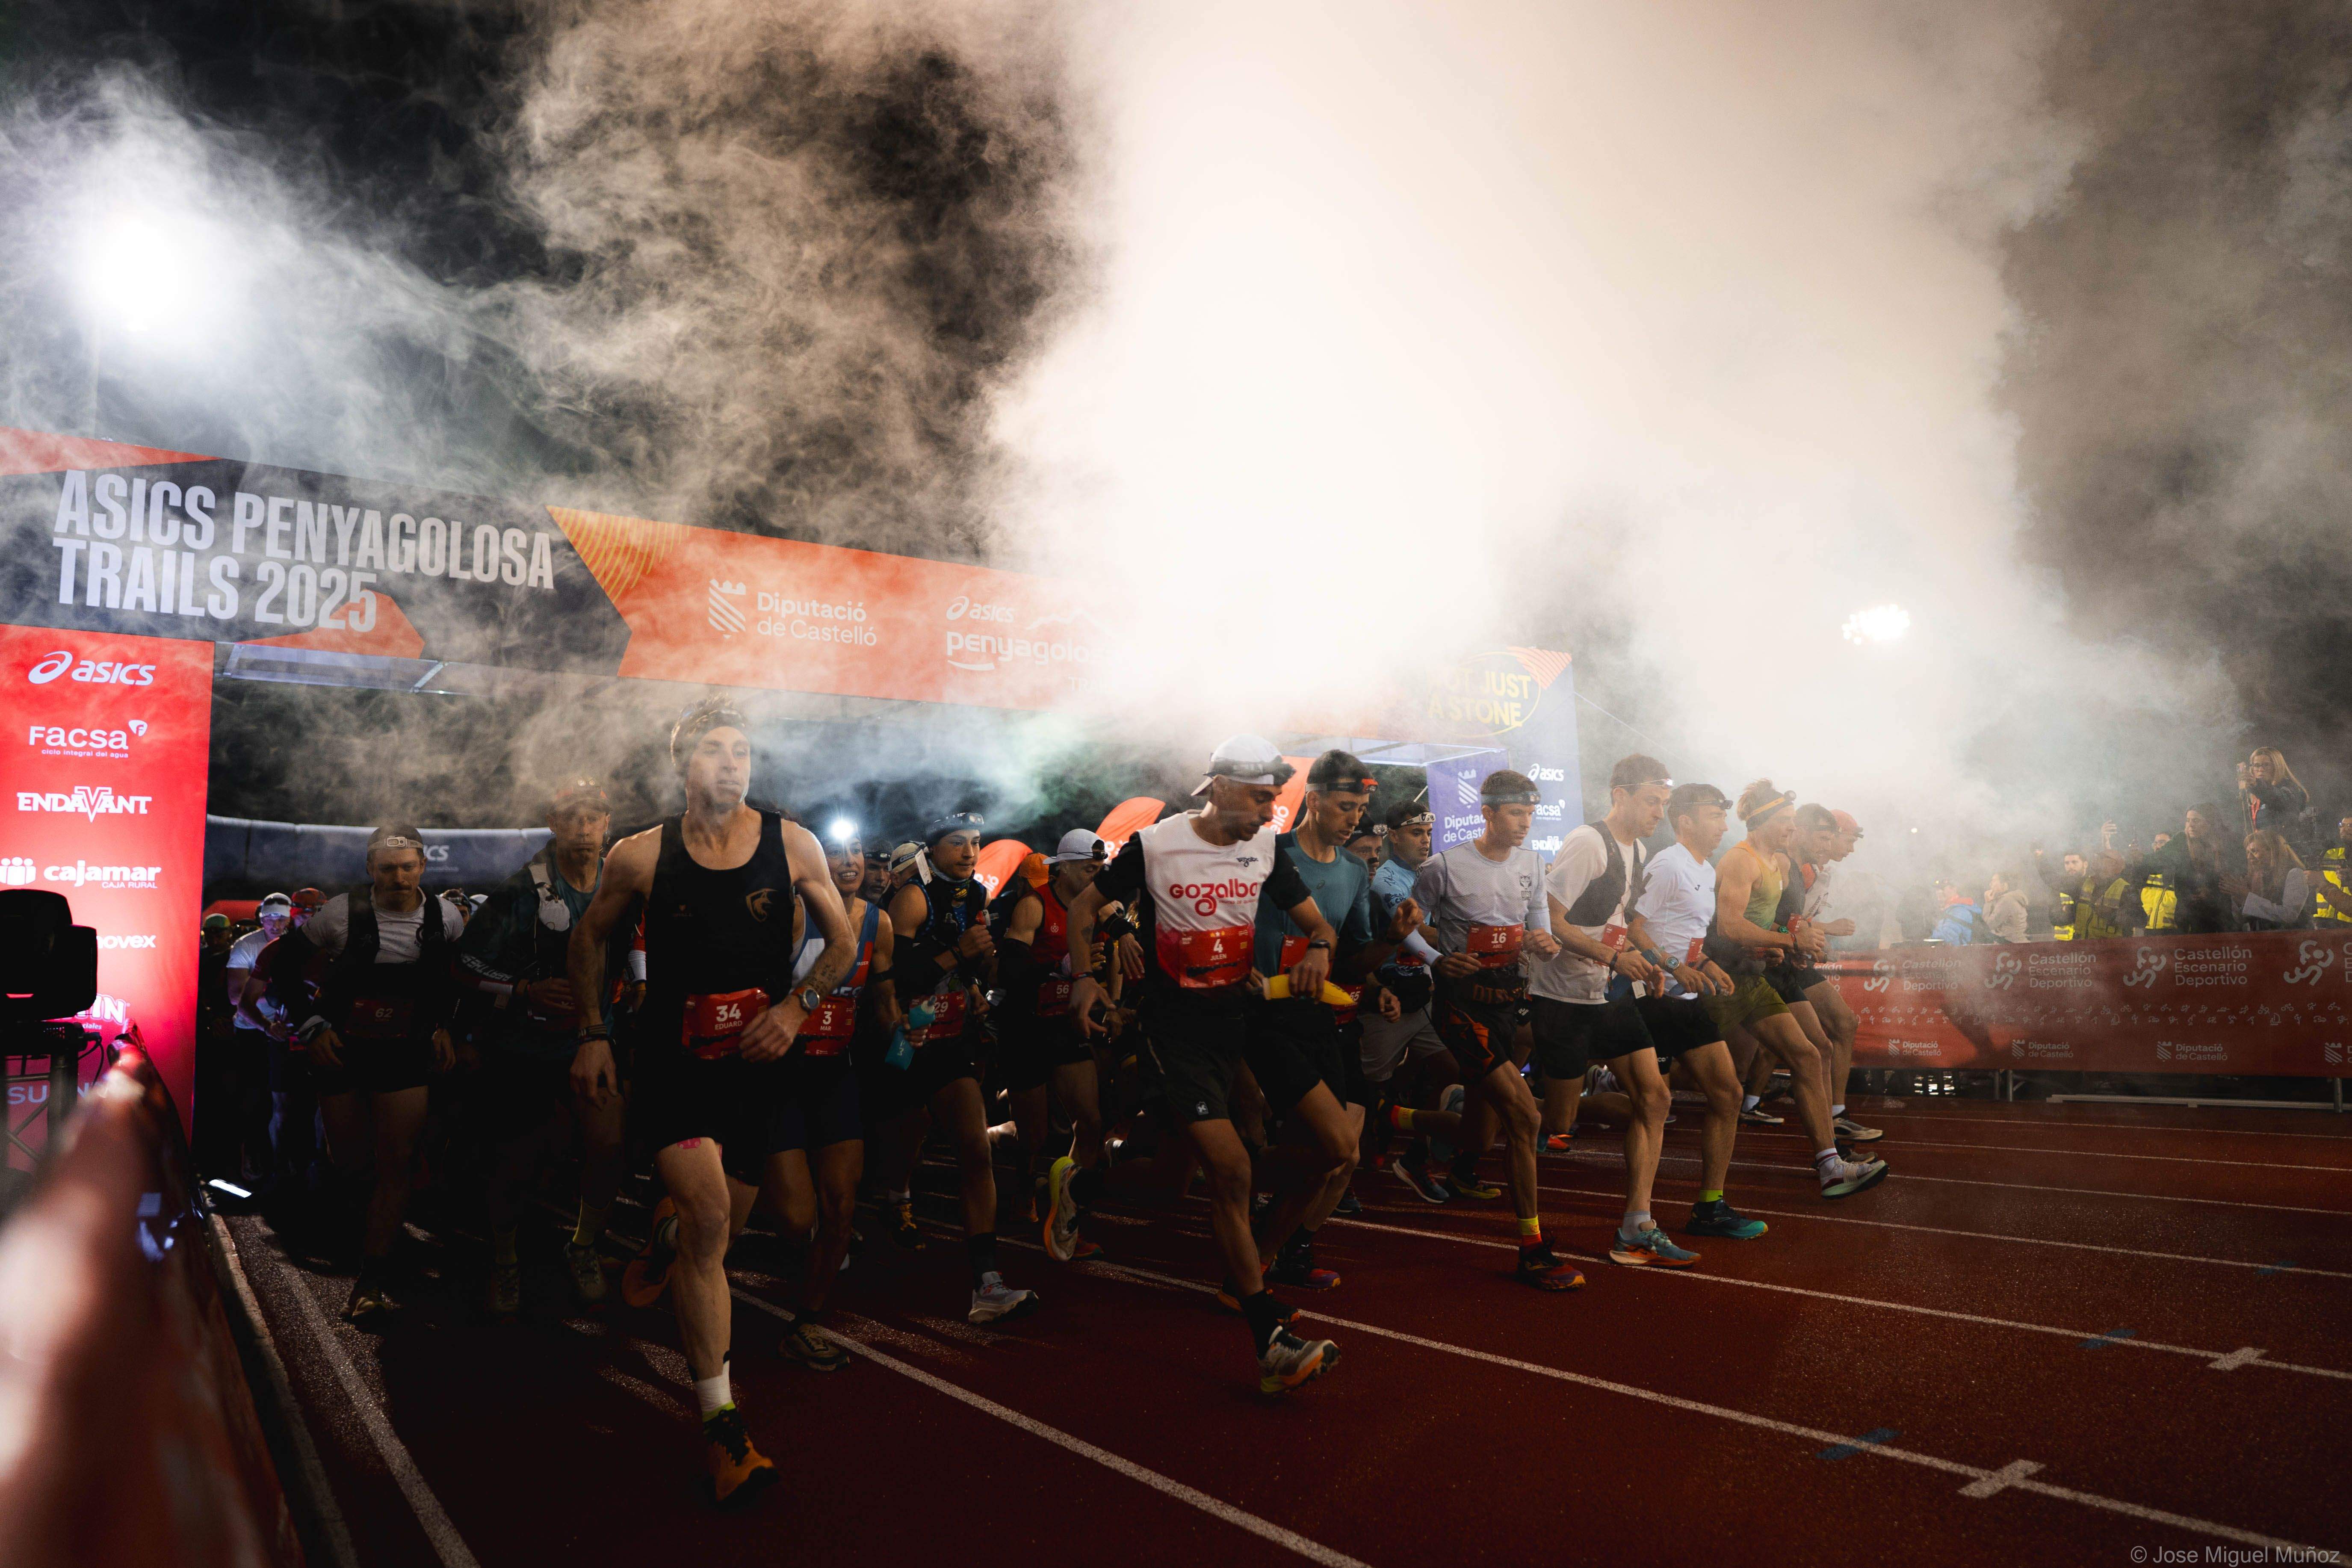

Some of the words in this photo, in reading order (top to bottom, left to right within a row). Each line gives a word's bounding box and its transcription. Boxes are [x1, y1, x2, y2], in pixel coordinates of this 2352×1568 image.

[53, 469, 216, 550] ASICS
[232, 492, 553, 589] PENYAGOLOSA
[53, 537, 239, 620] TRAILS
[255, 562, 376, 632] 2025
[758, 591, 867, 623] Diputació
[969, 603, 1015, 623] asics
[757, 618, 786, 636] de
[791, 620, 877, 646] Castelló
[71, 660, 156, 686] asics
[1480, 671, 1531, 700] JUST
[1427, 692, 1445, 719] A
[1448, 699, 1523, 727] STONE
[1539, 768, 1564, 782] asics
[17, 786, 152, 823] ENDAVANT
[1444, 814, 1486, 830] Diputac
[1443, 831, 1457, 843] de
[1458, 827, 1486, 841] Cast
[44, 860, 162, 887] cajamar
[1492, 933, 1507, 943] 16
[1214, 939, 1223, 953] 4
[2174, 945, 2252, 960] Castellón
[1903, 957, 1962, 969] Castellón
[2029, 951, 2096, 965] Castellón
[2029, 966, 2091, 976] Escenario
[2175, 960, 2246, 972] Escenario
[1903, 980, 1958, 992] Deportivo
[2030, 977, 2092, 989] Deportivo
[2175, 973, 2248, 988] Deportivo
[1056, 984, 1069, 994] 56
[375, 1008, 393, 1018] 62
[716, 1003, 742, 1022] 34
[934, 1001, 948, 1013] 29
[715, 1020, 743, 1030] EDUARD
[822, 1011, 832, 1025] 3
[1903, 1041, 1938, 1051] Diputació
[2029, 1042, 2069, 1051] Diputació
[2176, 1044, 2223, 1054] Diputació
[2040, 1050, 2074, 1058] Castelló
[2189, 1052, 2228, 1061] Castelló
